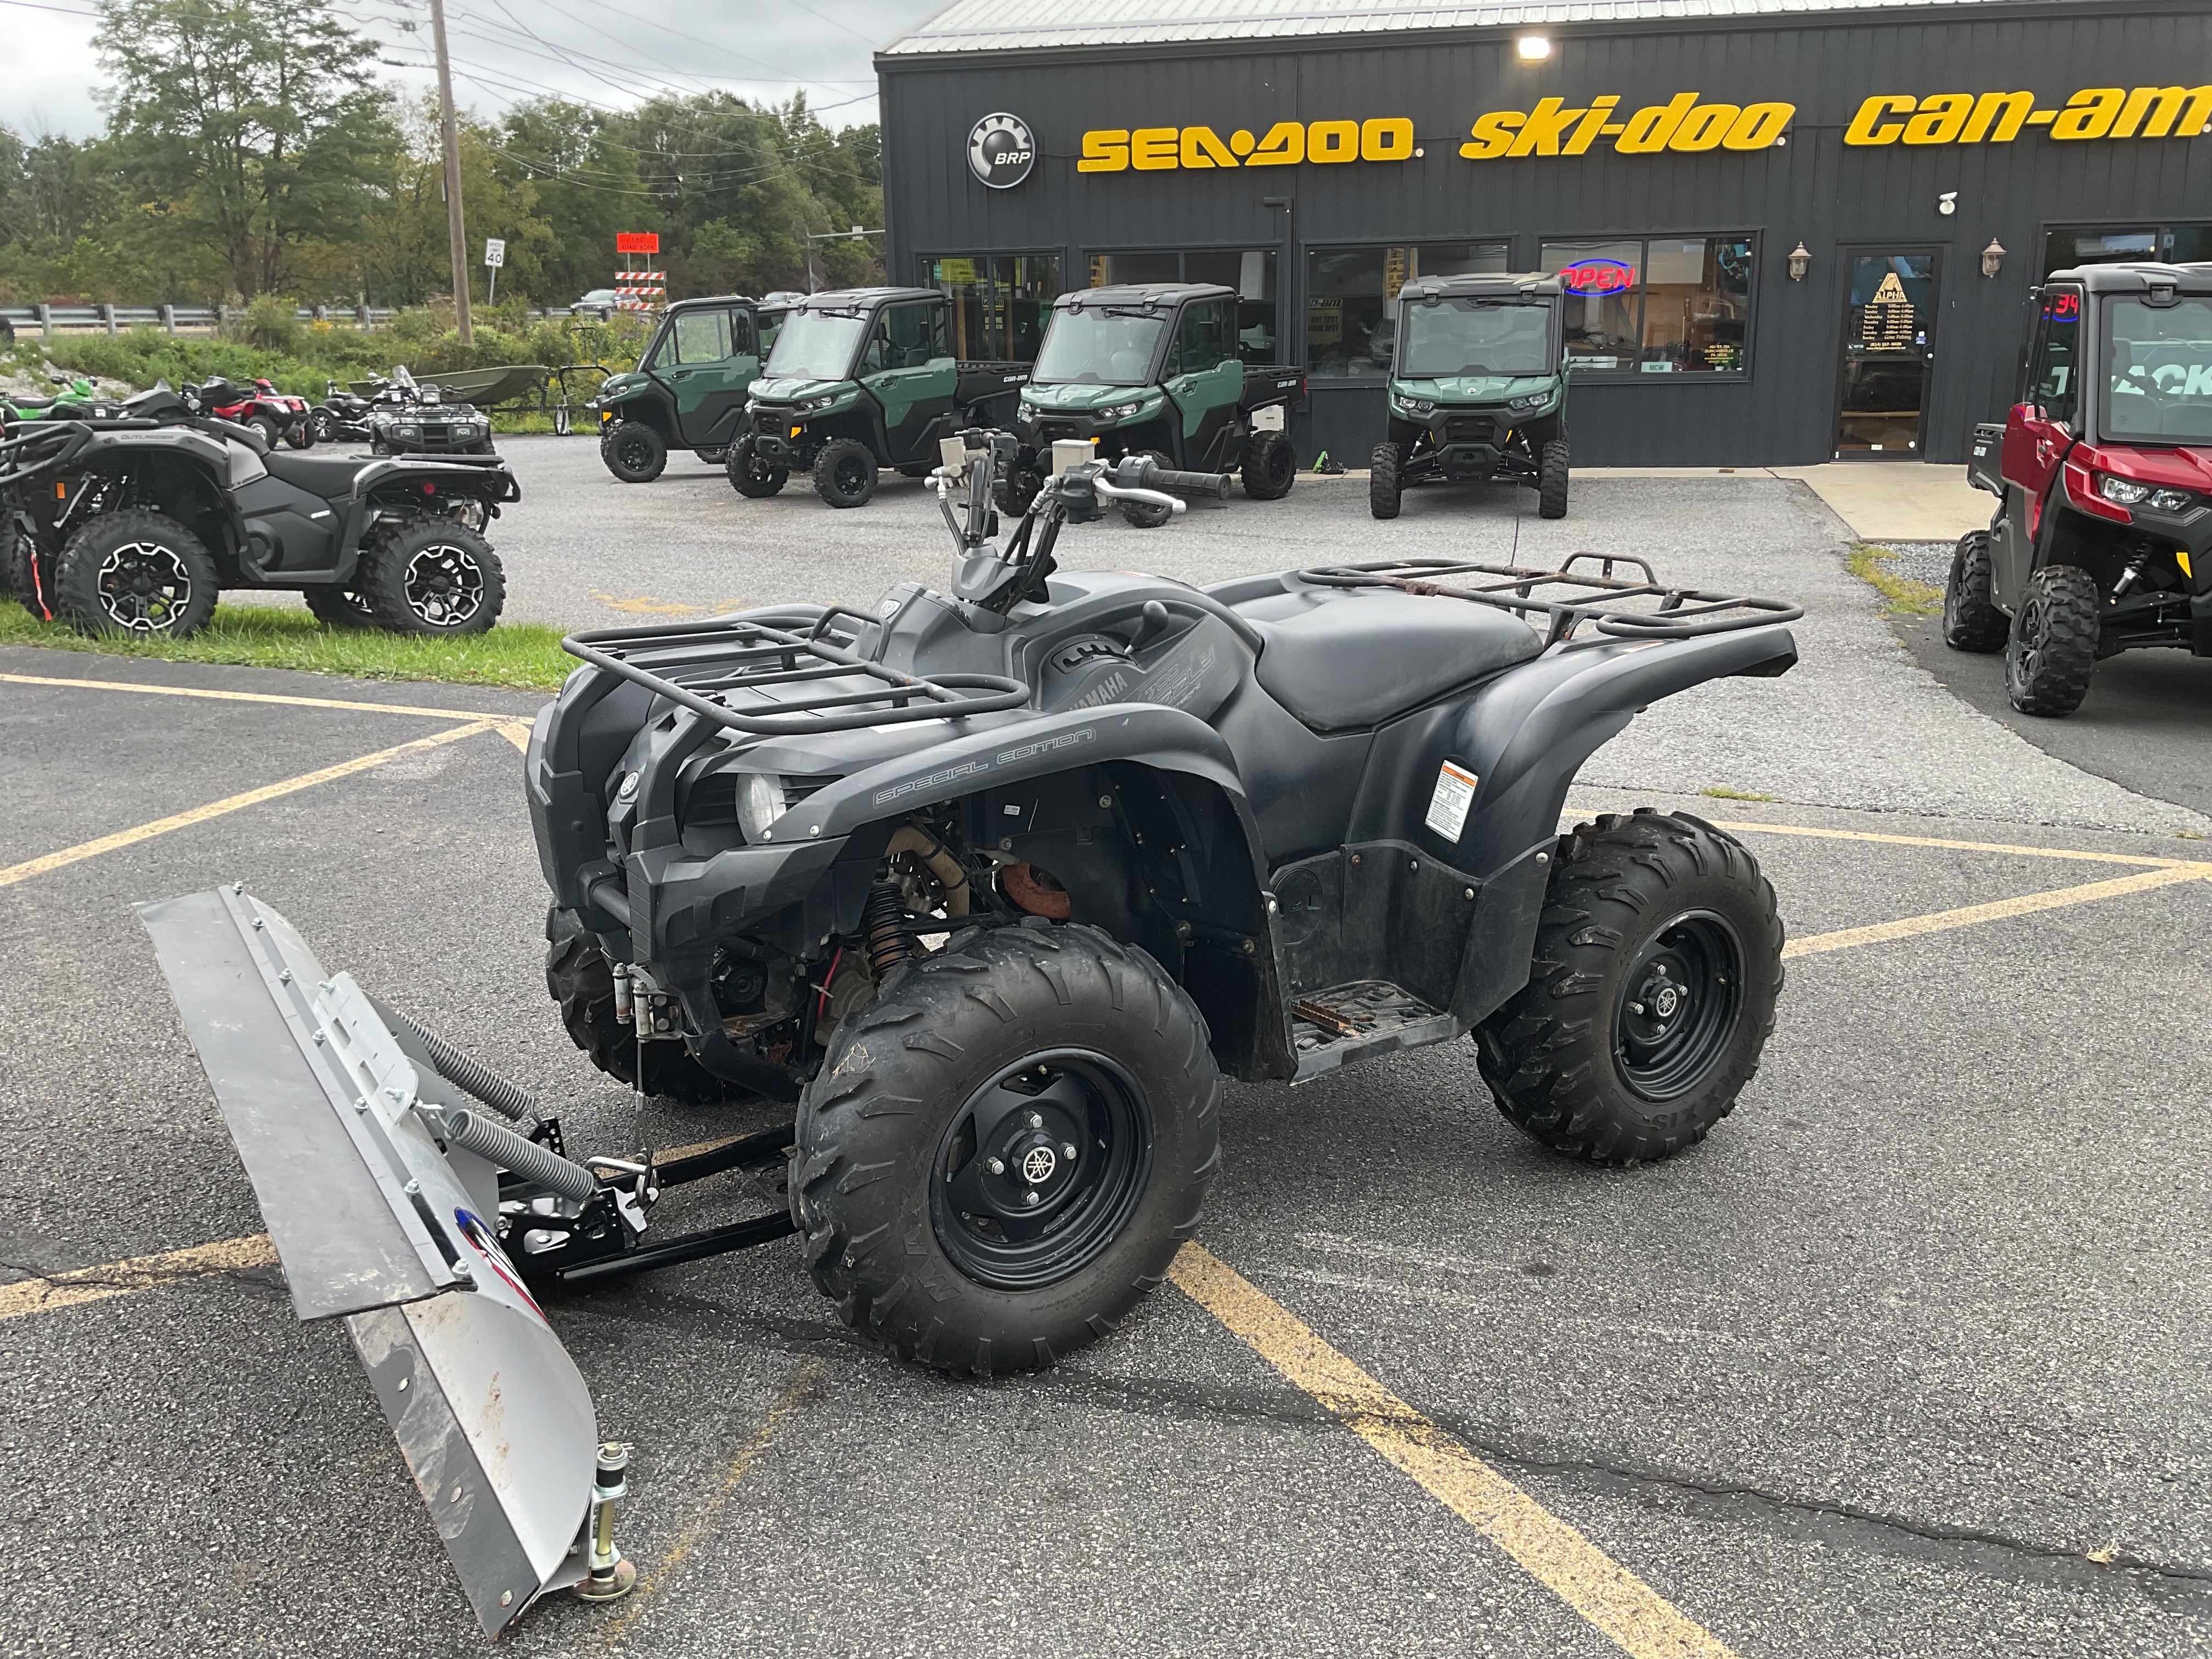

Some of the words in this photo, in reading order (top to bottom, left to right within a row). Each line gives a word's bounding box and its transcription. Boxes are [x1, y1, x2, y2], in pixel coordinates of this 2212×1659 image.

[1844, 86, 2212, 145] can-am
[1459, 92, 1796, 159] ski-doo
[995, 152, 1031, 165] BRP
[487, 253, 502, 263] 40
[1559, 268, 1635, 289] OPEN
[1876, 291, 1905, 300] ALPHA
[1003, 374, 1028, 383] can-am
[1277, 380, 1296, 388] can-am
[1145, 663, 1179, 701] 700
[874, 761, 988, 804] SPECIAL
[997, 727, 1094, 764] EDITION
